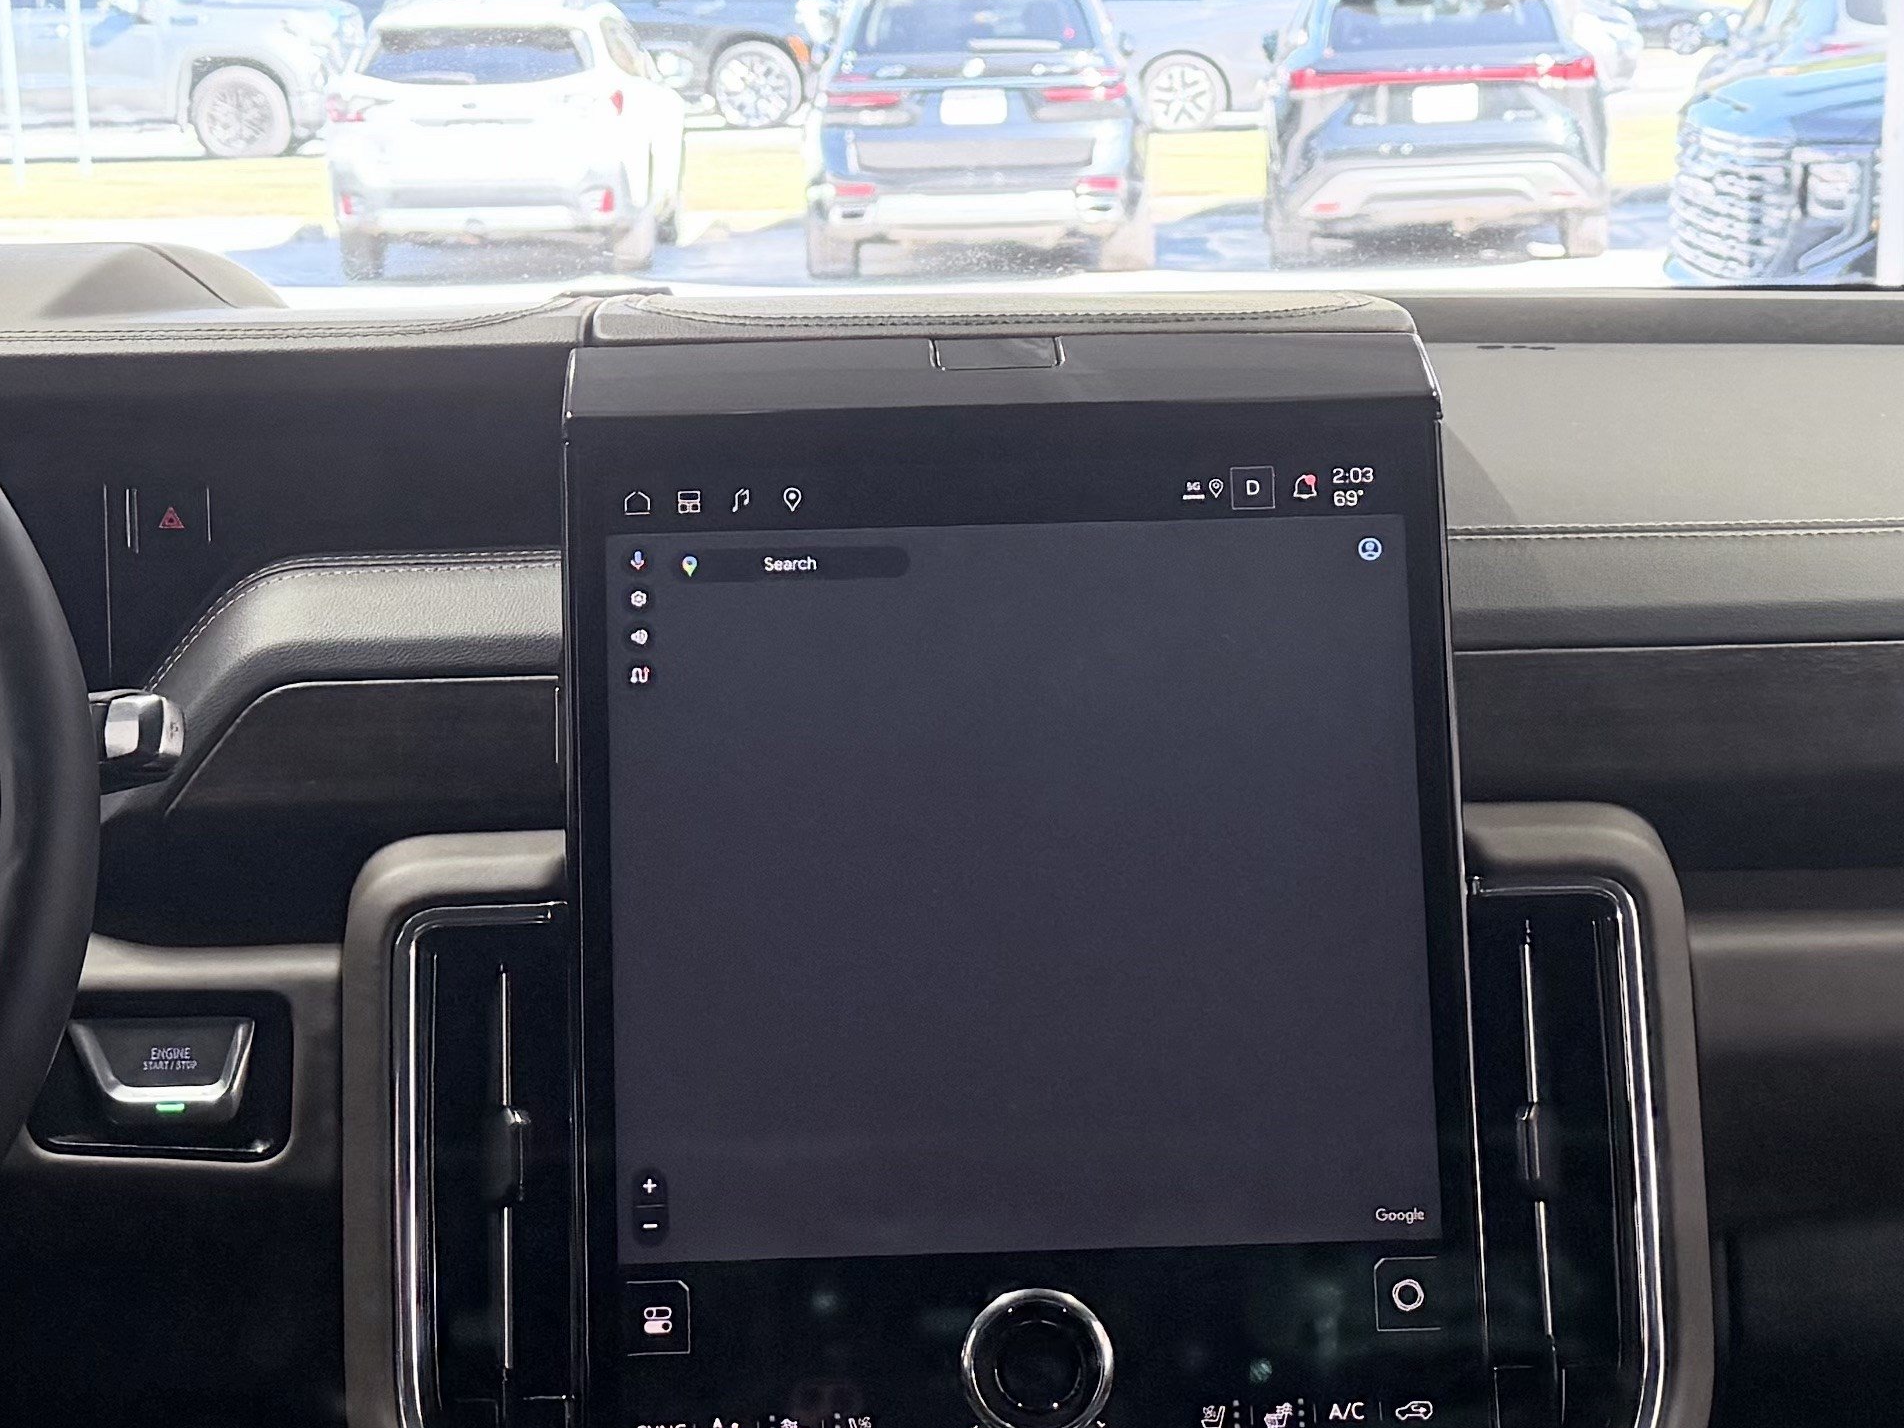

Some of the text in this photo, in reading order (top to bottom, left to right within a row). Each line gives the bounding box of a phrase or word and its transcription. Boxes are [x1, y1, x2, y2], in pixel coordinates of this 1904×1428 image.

[1332, 466, 1374, 484] 2:03
[1332, 489, 1365, 507] 69°
[763, 555, 818, 572] Search
[150, 1047, 191, 1060] ENGINE
[1375, 1207, 1425, 1225] Google
[1328, 1402, 1366, 1421] A/C
